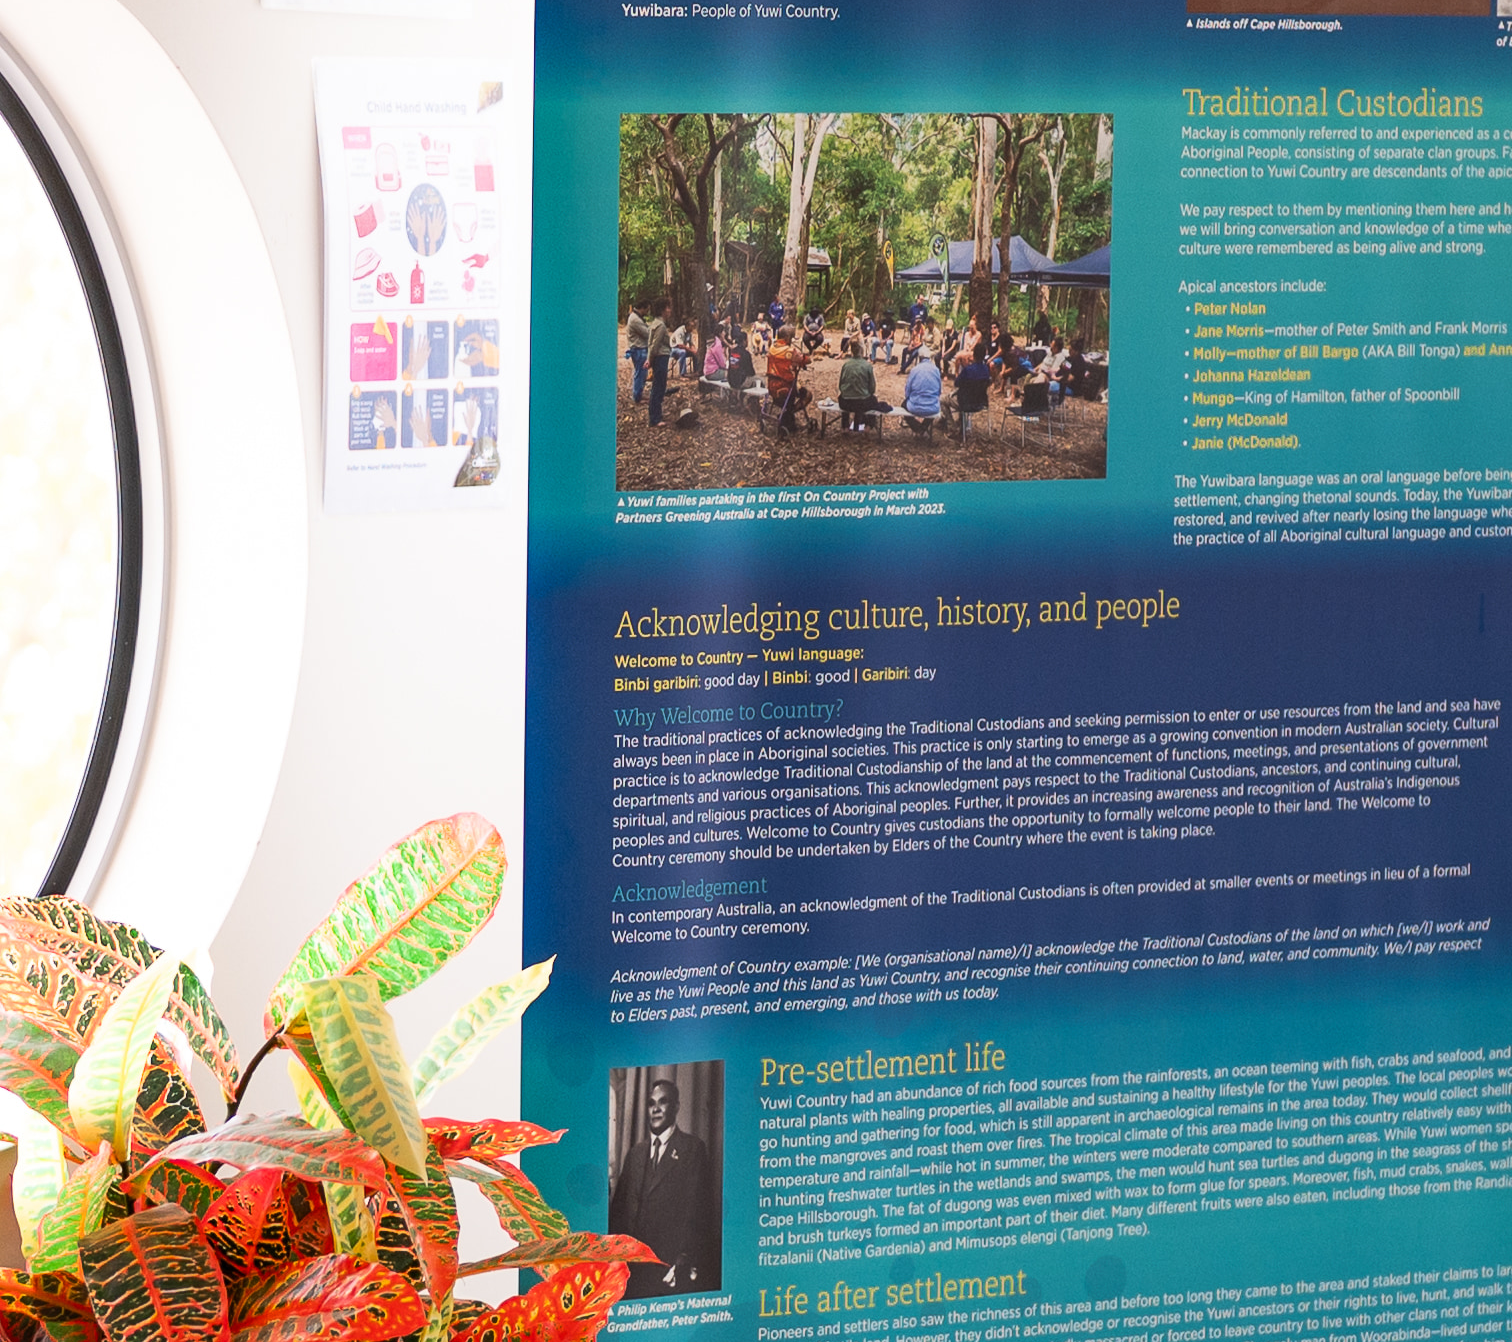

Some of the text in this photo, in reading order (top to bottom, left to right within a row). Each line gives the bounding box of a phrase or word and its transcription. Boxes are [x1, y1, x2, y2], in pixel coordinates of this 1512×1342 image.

[1195, 17, 1343, 32] Islands off Cape Hillsborough.
[366, 101, 468, 116] Child Hand Washing
[1182, 86, 1483, 117] Traditional Custodians
[1194, 302, 1267, 316] Peter Nolan
[613, 588, 1180, 641] Acknowledging culture, history, and people
[612, 697, 843, 731] Why Welcome to Country?
[610, 877, 768, 903] Acknowledgement
[760, 1041, 1005, 1086] Pre-settlement life
[616, 1302, 648, 1317] Philip
[685, 1293, 732, 1309] Maternal
[758, 1268, 1027, 1317] Life after settlement
[606, 1309, 733, 1335] Grandfather, Peter Smith.
